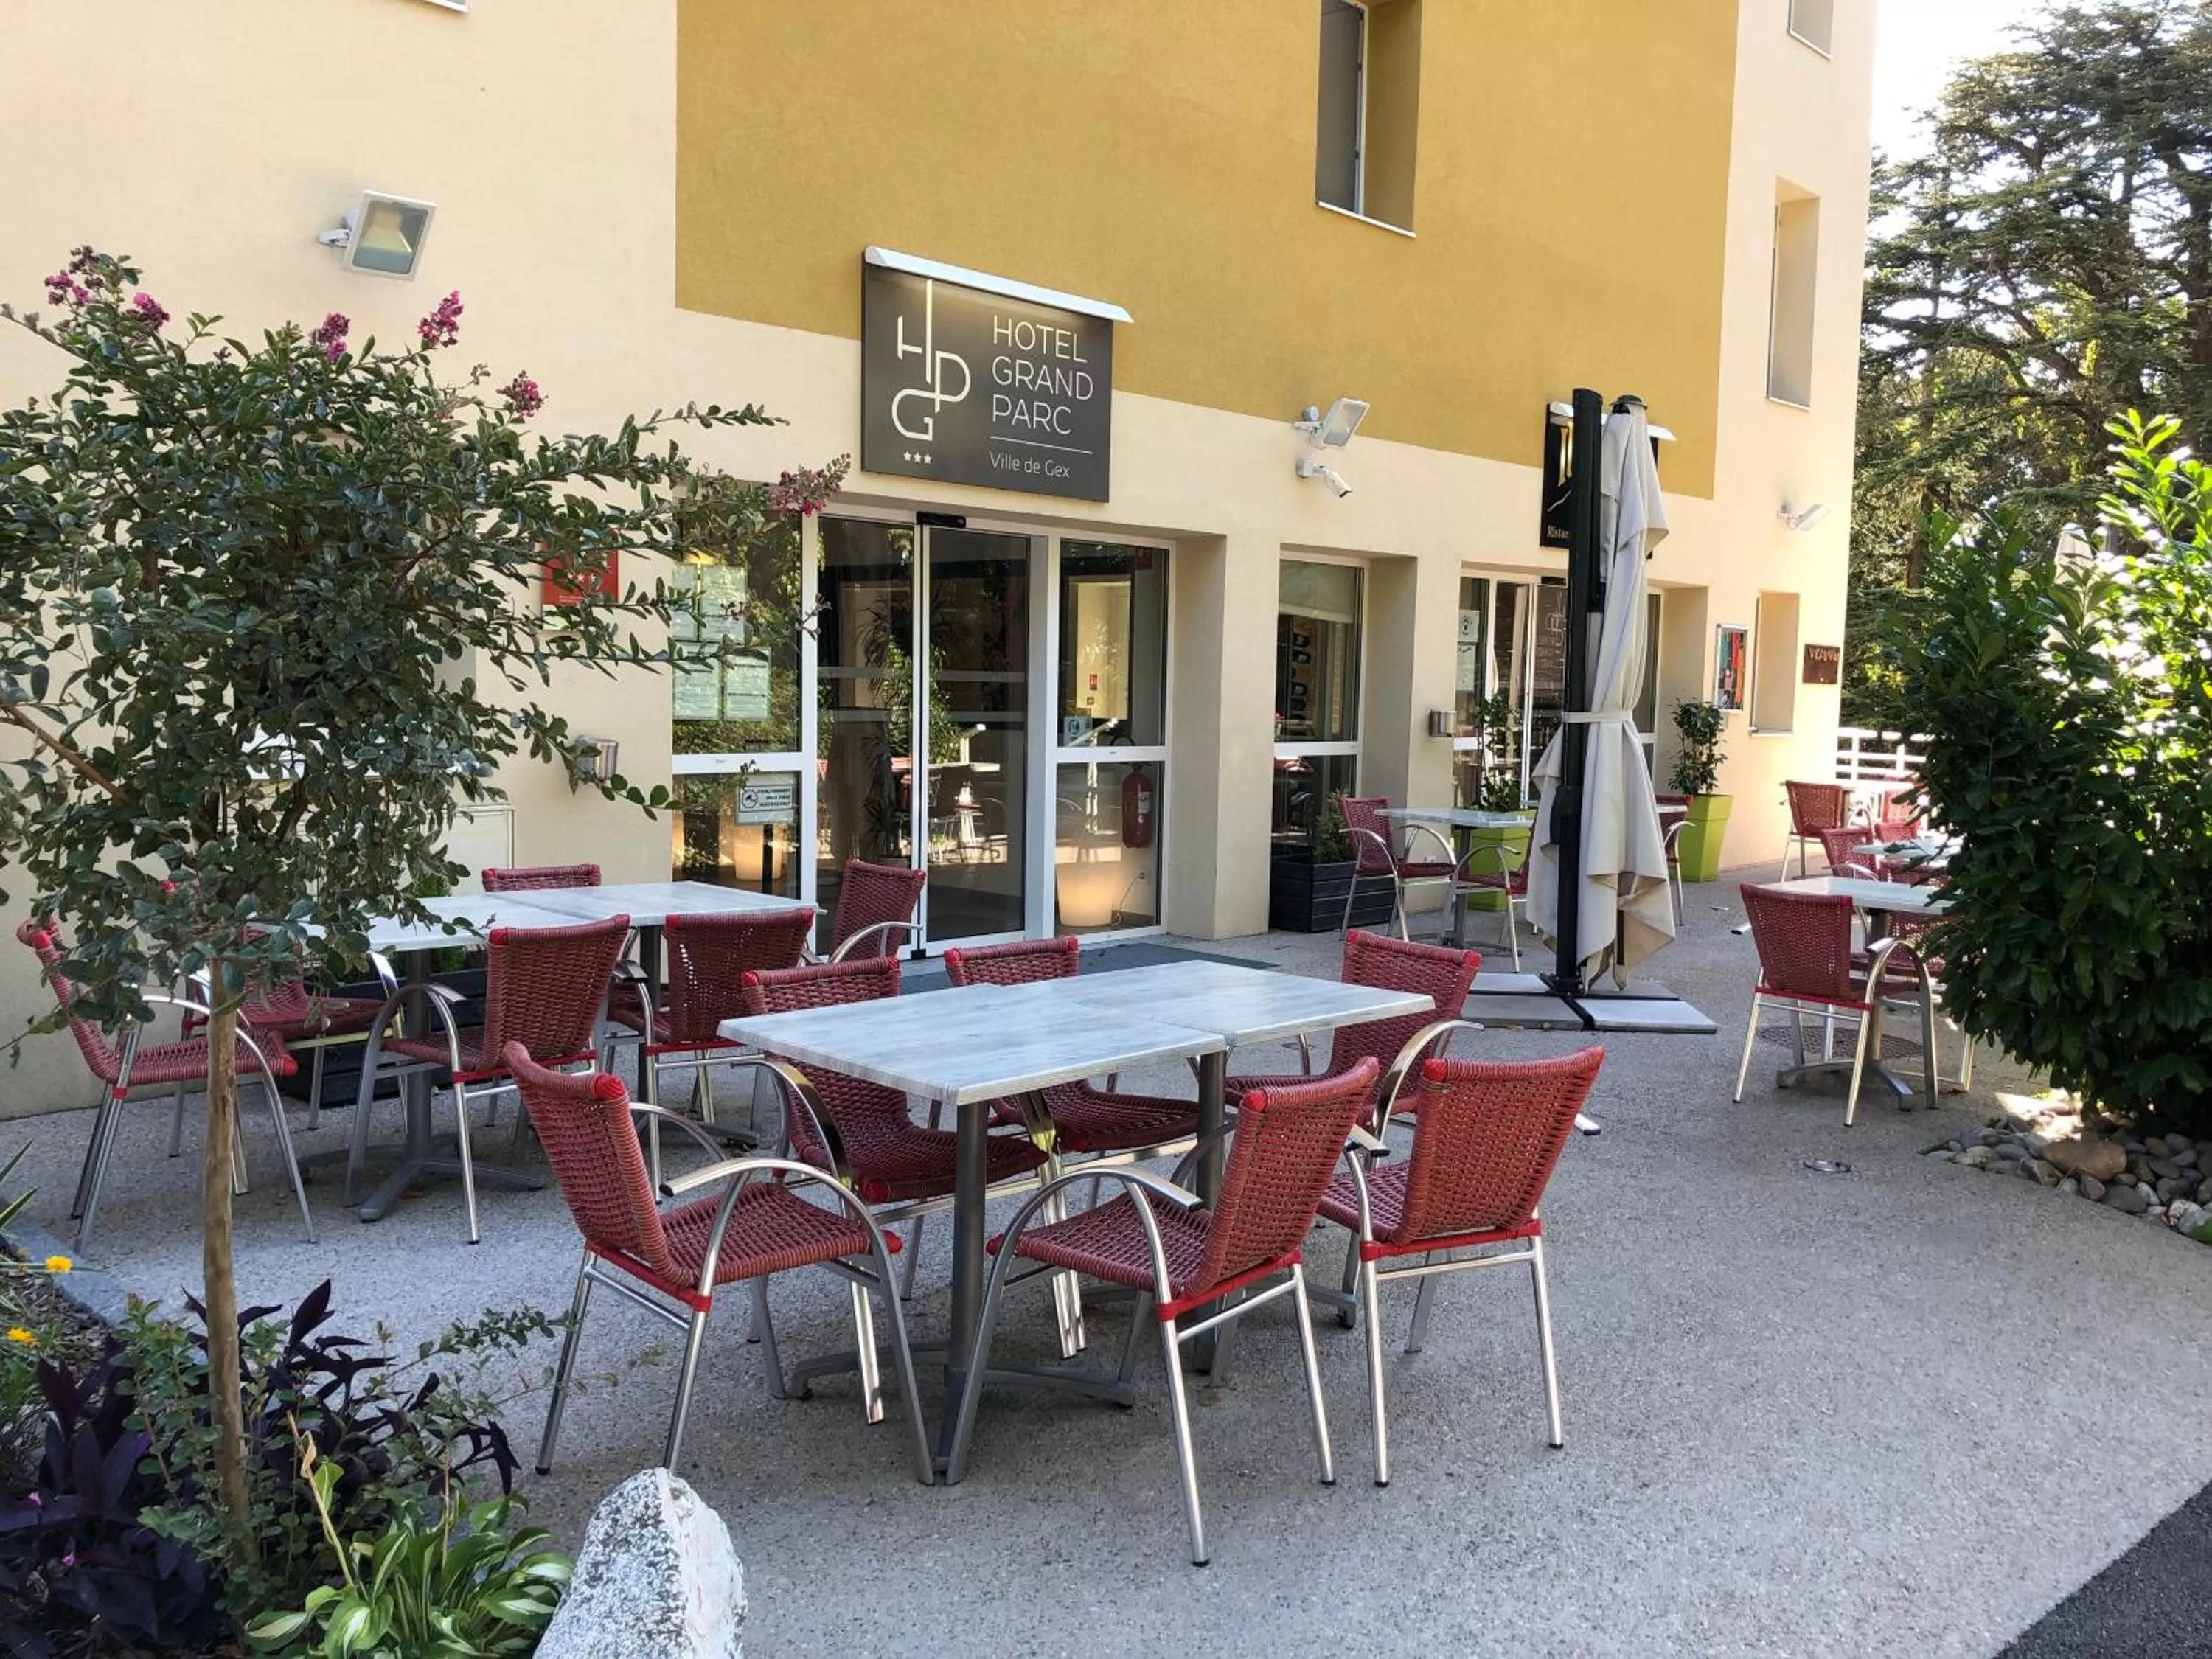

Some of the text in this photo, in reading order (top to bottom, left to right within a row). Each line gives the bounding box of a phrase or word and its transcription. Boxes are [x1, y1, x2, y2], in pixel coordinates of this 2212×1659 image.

[993, 314, 1088, 364] HOTEL
[992, 355, 1094, 401] GRAND
[992, 394, 1072, 435] PARC
[988, 451, 1070, 479] Ville de Gex
